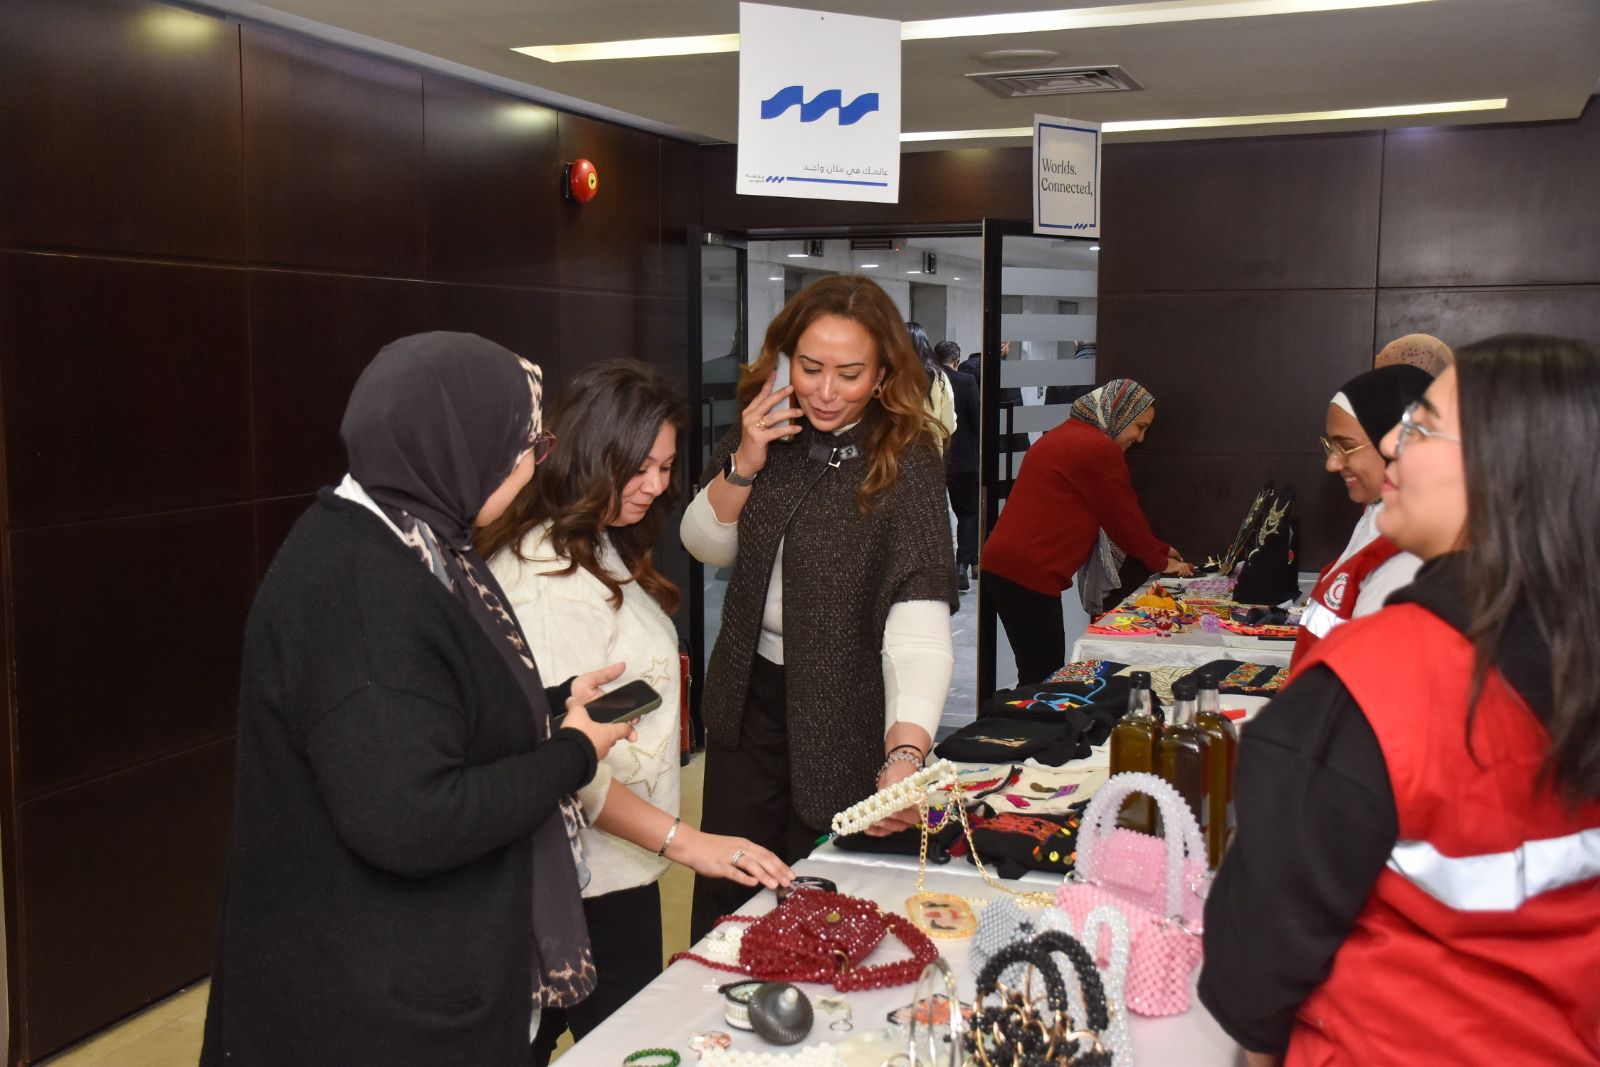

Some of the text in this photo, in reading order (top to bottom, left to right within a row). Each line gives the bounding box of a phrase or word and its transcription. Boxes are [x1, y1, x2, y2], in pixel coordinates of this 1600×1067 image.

[803, 162, 825, 174] واحد
[826, 163, 845, 175] مكان
[1041, 158, 1077, 176] Worlds.
[1041, 177, 1093, 197] Connected,
